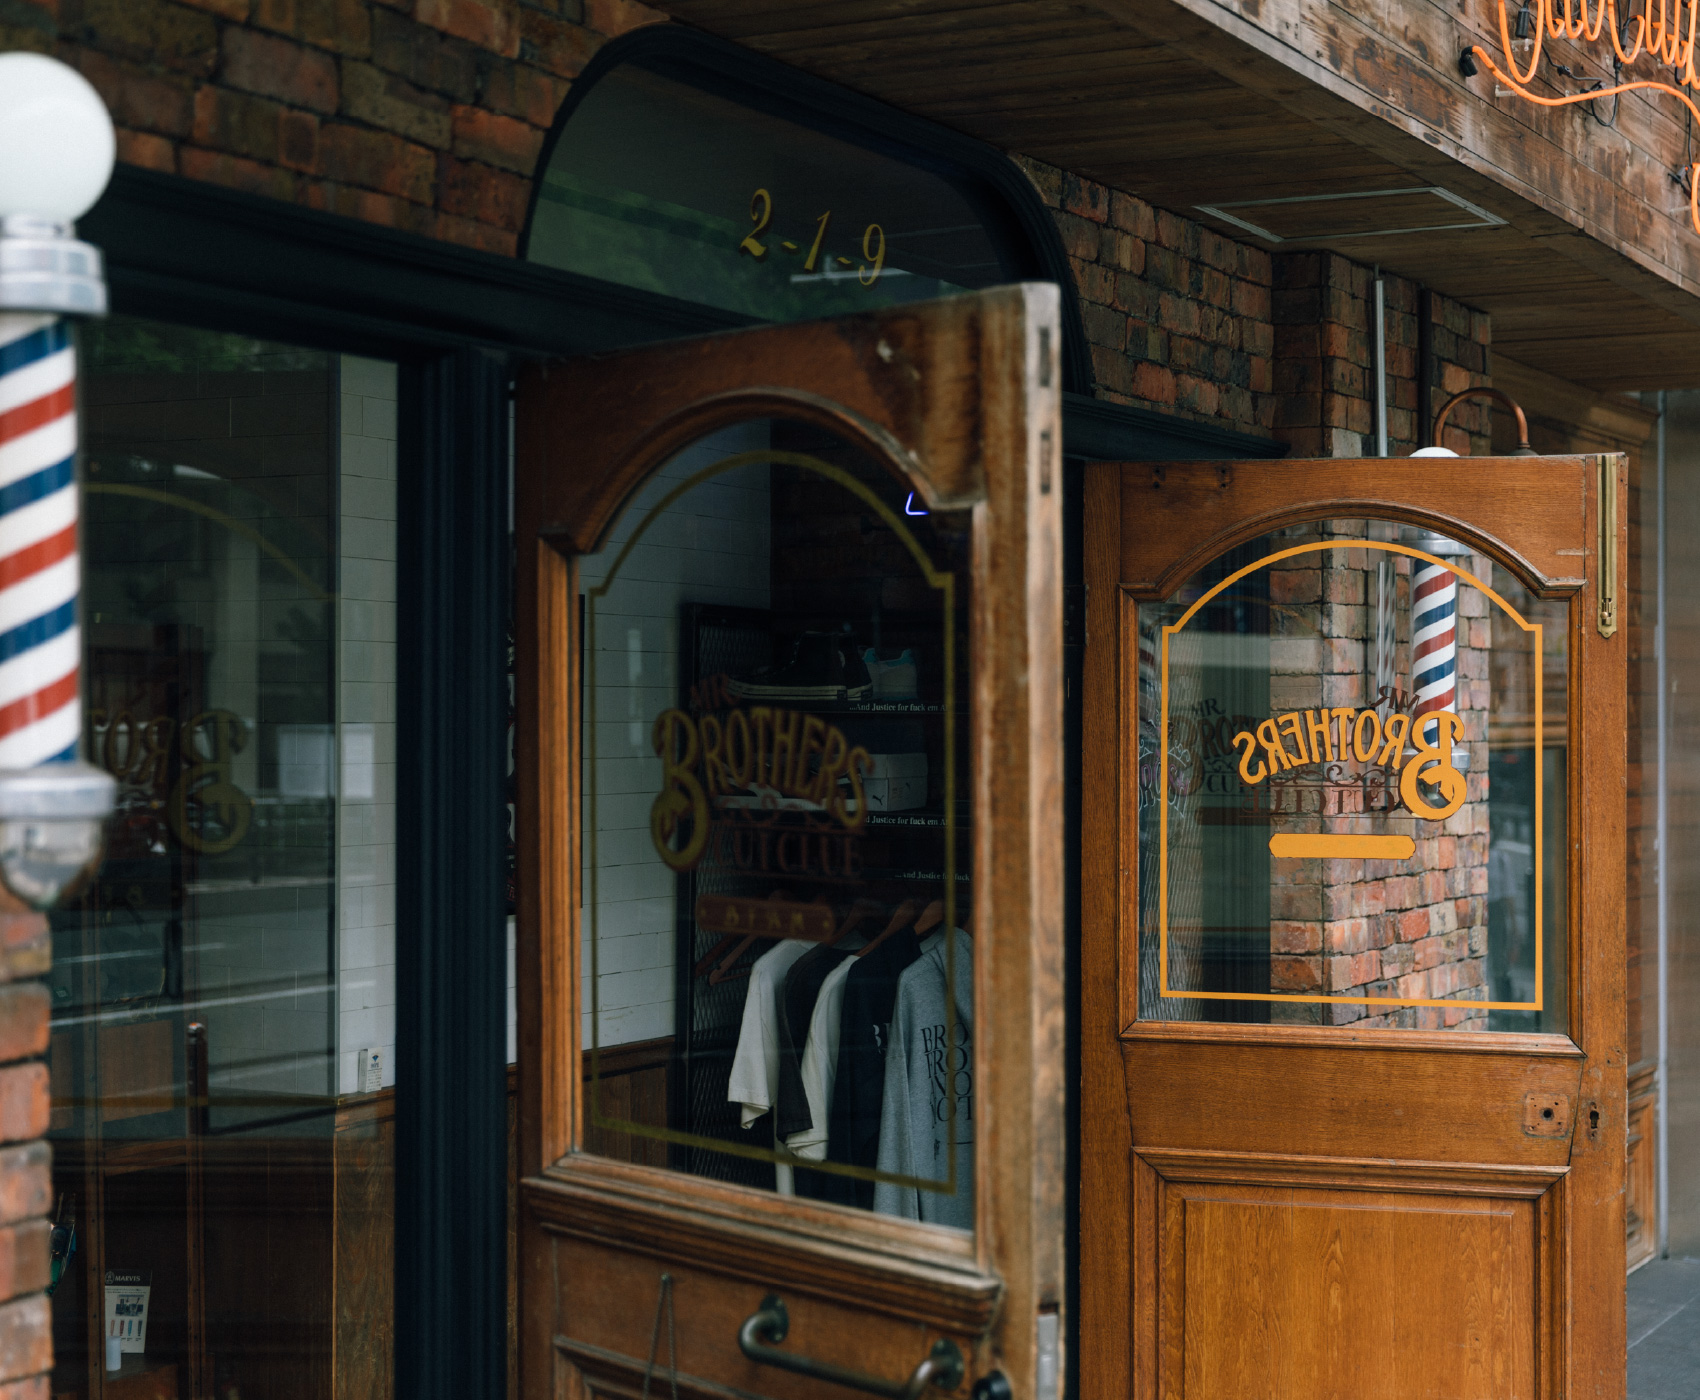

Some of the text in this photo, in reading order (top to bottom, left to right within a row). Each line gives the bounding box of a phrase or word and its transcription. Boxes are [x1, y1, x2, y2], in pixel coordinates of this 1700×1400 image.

[739, 188, 886, 286] 2-1-9
[872, 703, 896, 711] Justice
[897, 703, 909, 711] for
[910, 703, 926, 712] fuck
[652, 707, 874, 871] BROTHERS
[871, 815, 896, 824] Justice
[897, 816, 908, 825] for
[910, 816, 926, 825] fuck
[927, 818, 938, 826] em
[917, 872, 941, 880] Justice
[954, 873, 970, 881] fuck
